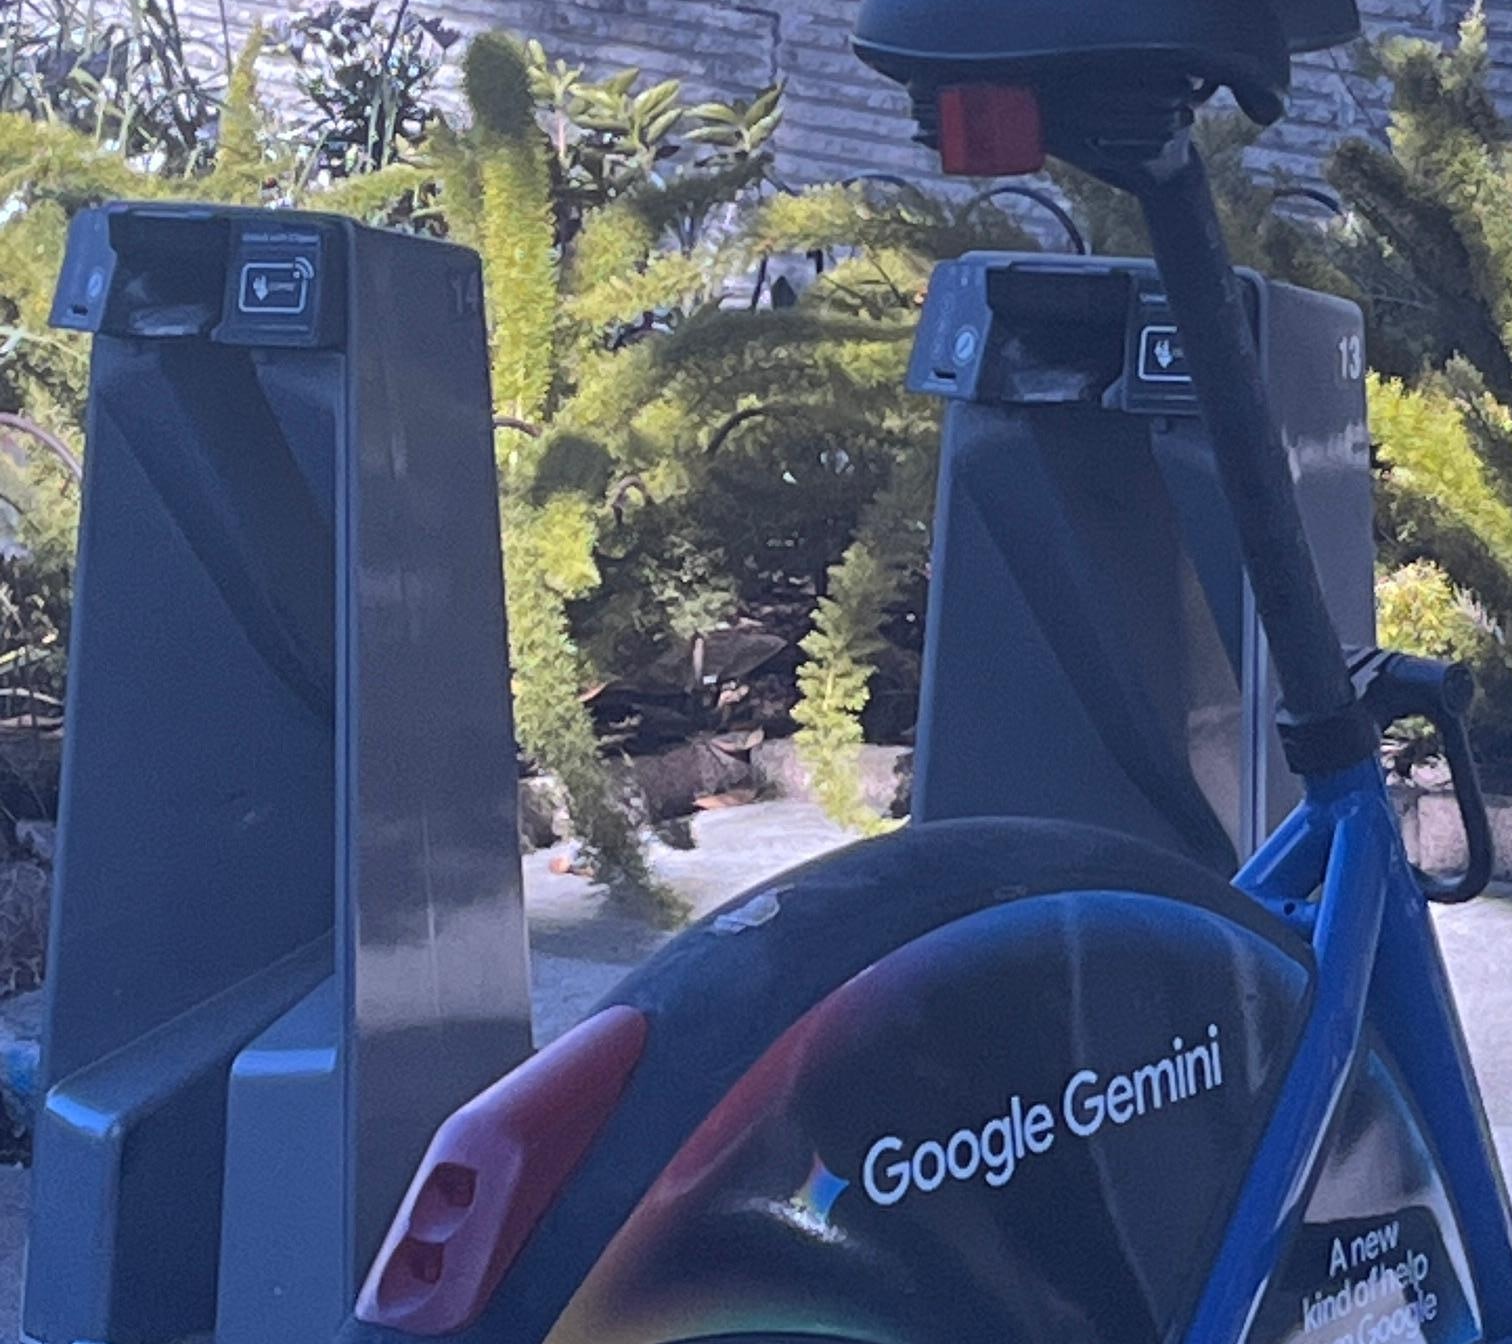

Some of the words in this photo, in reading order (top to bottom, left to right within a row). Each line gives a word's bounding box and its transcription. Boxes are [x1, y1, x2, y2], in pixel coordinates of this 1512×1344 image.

[1338, 334, 1362, 381] 13
[862, 1095, 1055, 1206] Google
[1062, 1023, 1224, 1138] Gemini
[1329, 1237, 1349, 1277] A
[1350, 1220, 1400, 1267] new
[1302, 1277, 1352, 1334] kind
[1353, 1263, 1377, 1309] of
[1378, 1249, 1430, 1298] help
